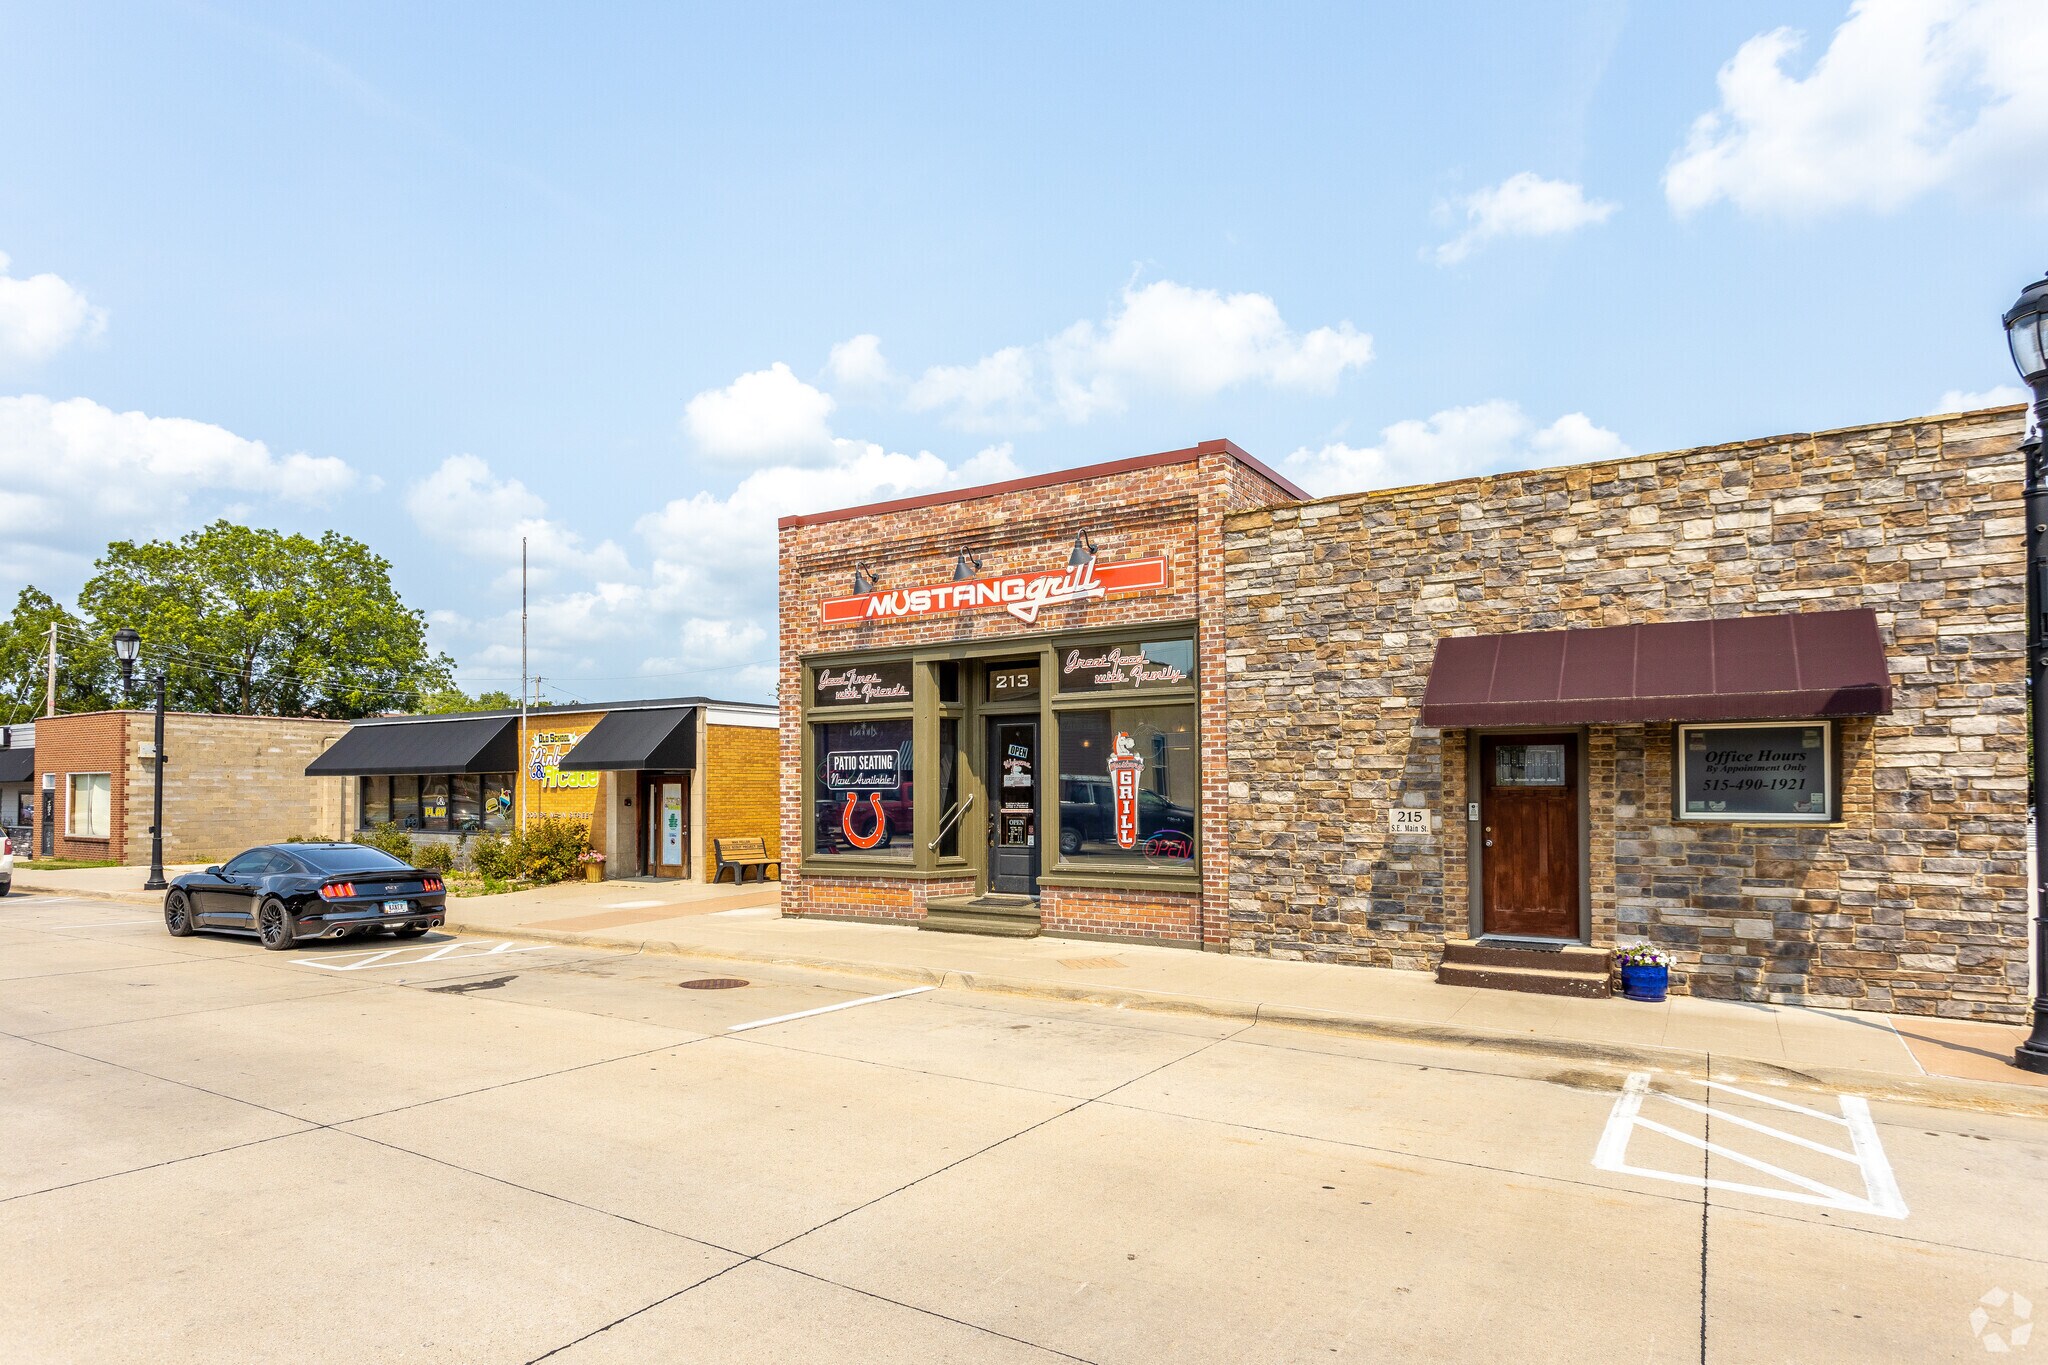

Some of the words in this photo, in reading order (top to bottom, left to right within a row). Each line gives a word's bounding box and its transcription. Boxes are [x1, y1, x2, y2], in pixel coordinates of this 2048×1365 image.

[866, 579, 1025, 616] MUSTANG
[1008, 556, 1105, 623] grill
[1064, 649, 1111, 674] Great
[1108, 648, 1150, 674] Food
[818, 669, 849, 690] Good
[847, 668, 882, 690] Times
[996, 674, 1029, 688] 213
[1095, 669, 1130, 684] with
[1130, 664, 1187, 687] Family
[836, 686, 861, 699] with
[861, 683, 910, 703] Friends
[1010, 745, 1027, 757] OPEN
[1705, 751, 1753, 766] Office
[1758, 749, 1807, 762] Hours
[531, 762, 545, 778] &
[834, 755, 857, 771] PATIO
[859, 755, 893, 770] SEATING
[1706, 765, 1718, 774] By
[1720, 764, 1780, 774] Appointment
[1783, 763, 1807, 773] Only
[831, 773, 851, 786] Now
[852, 772, 897, 785] Available!
[1703, 778, 1806, 792] 515-490-1921
[425, 806, 447, 818] PLAY
[1119, 771, 1134, 844] GRILL
[1397, 811, 1423, 823] 215
[1405, 824, 1419, 832] Main
[1144, 838, 1193, 859] OPEN
